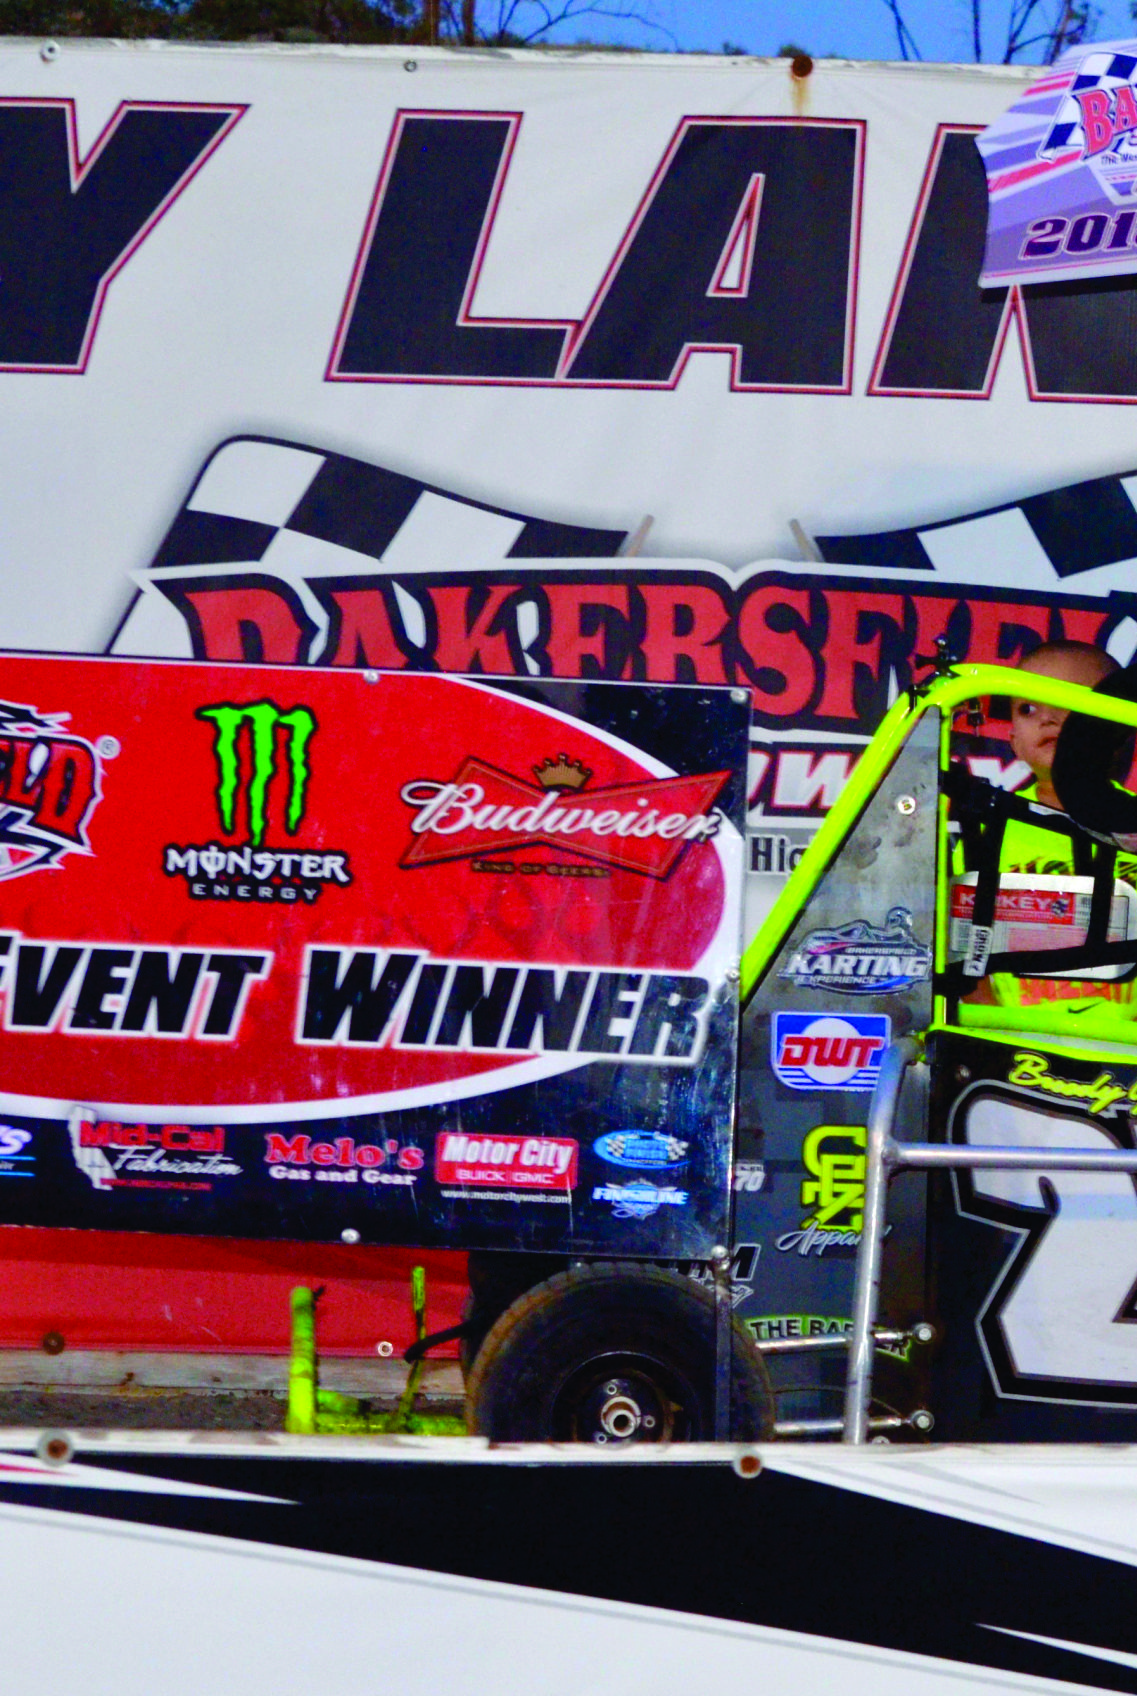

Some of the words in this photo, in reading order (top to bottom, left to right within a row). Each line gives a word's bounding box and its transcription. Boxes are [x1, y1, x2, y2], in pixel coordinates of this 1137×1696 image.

[400, 779, 722, 845] Budweiser
[164, 845, 351, 884] MONSTER
[191, 882, 319, 901] ENERGY
[959, 892, 1050, 911] KKEY
[787, 952, 930, 977] KARTING
[294, 944, 710, 1067] WINNER
[779, 1035, 883, 1069] DWT
[80, 1119, 226, 1153] Mid-Cal
[264, 1132, 425, 1170] Melo's
[441, 1135, 520, 1165] Motor
[520, 1139, 573, 1174] City
[268, 1164, 312, 1181] Gas
[314, 1168, 359, 1183] and
[361, 1169, 418, 1186] Gear
[455, 1168, 505, 1181] BUICK
[512, 1171, 555, 1184] GMC
